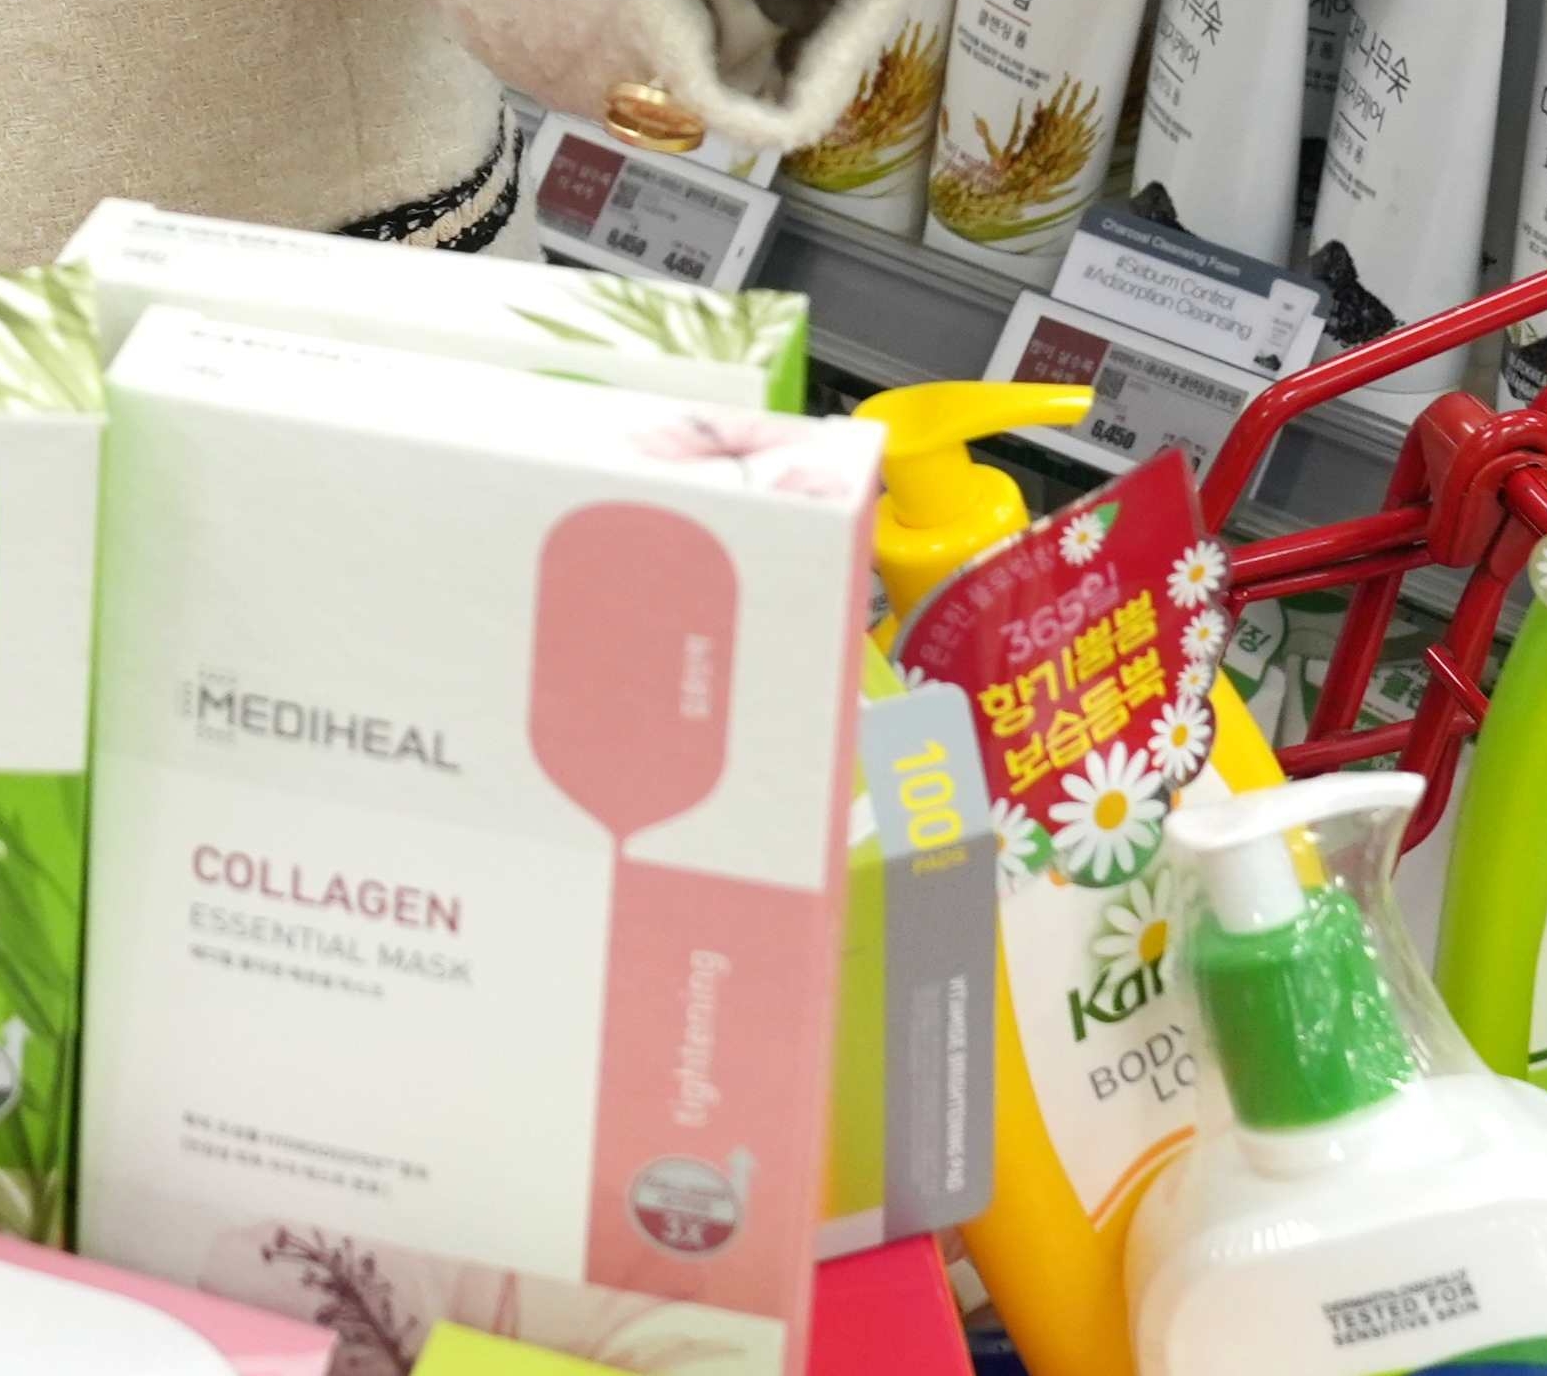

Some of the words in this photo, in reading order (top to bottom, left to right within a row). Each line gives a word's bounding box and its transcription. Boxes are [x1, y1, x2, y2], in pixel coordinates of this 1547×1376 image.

[977, 590, 1159, 738] 향기뿜뿜
[195, 684, 464, 774] MEDIHEAL
[1004, 651, 1169, 796] 보습듬뿍
[892, 739, 962, 850] 100
[190, 843, 464, 936] COLLAGEN
[188, 901, 365, 966] ESSENTIAL
[376, 941, 476, 988] MASK
[1326, 1298, 1420, 1333] TESTED
[1428, 1279, 1476, 1311] FOR
